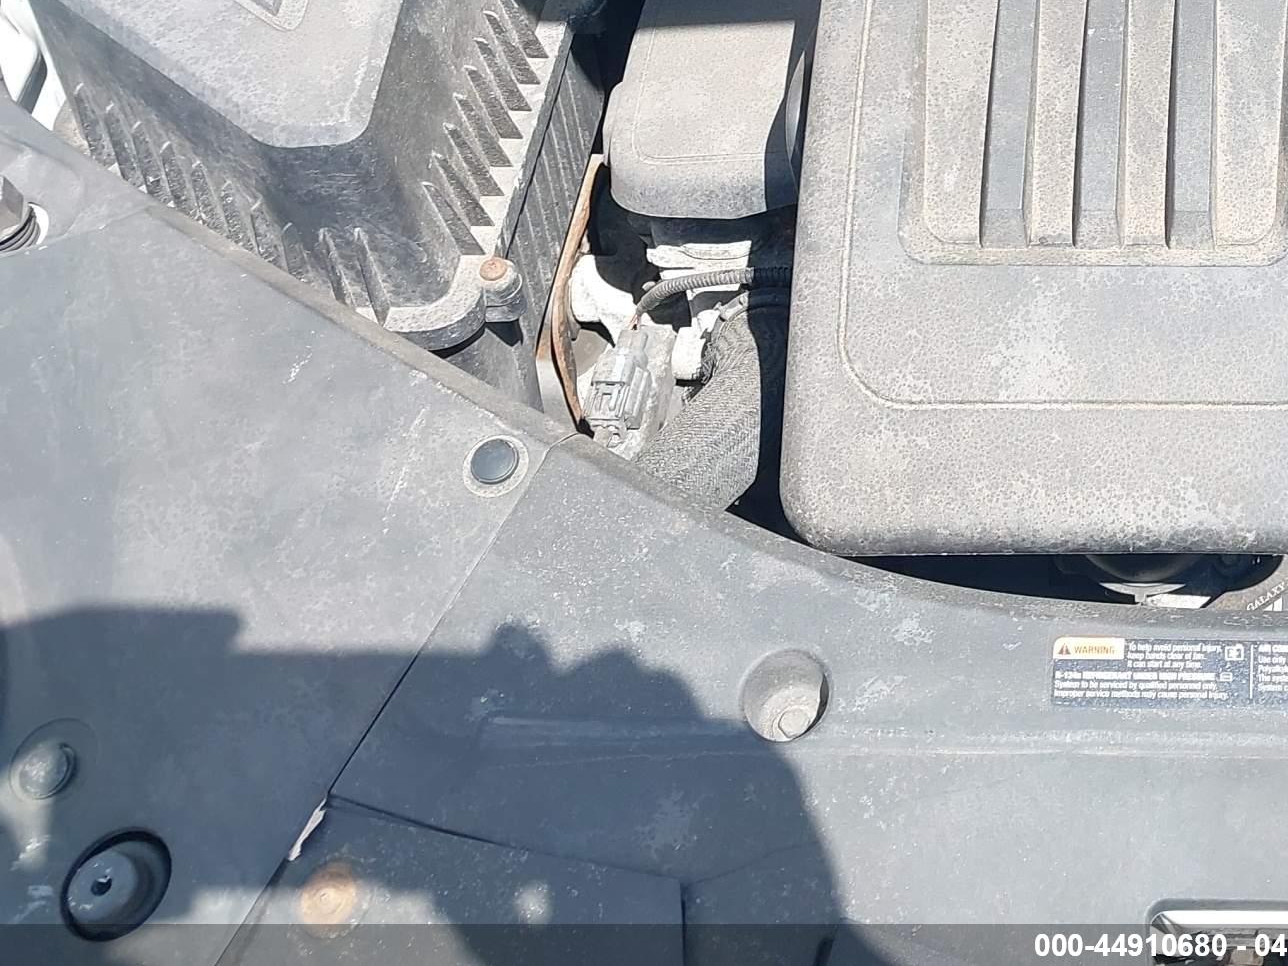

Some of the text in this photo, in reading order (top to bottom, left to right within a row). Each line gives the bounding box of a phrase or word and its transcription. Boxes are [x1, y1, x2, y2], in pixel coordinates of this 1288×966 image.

[1246, 581, 1285, 611] GALAXY
[1075, 646, 1115, 654] WARNING
[1271, 656, 1286, 665] only
